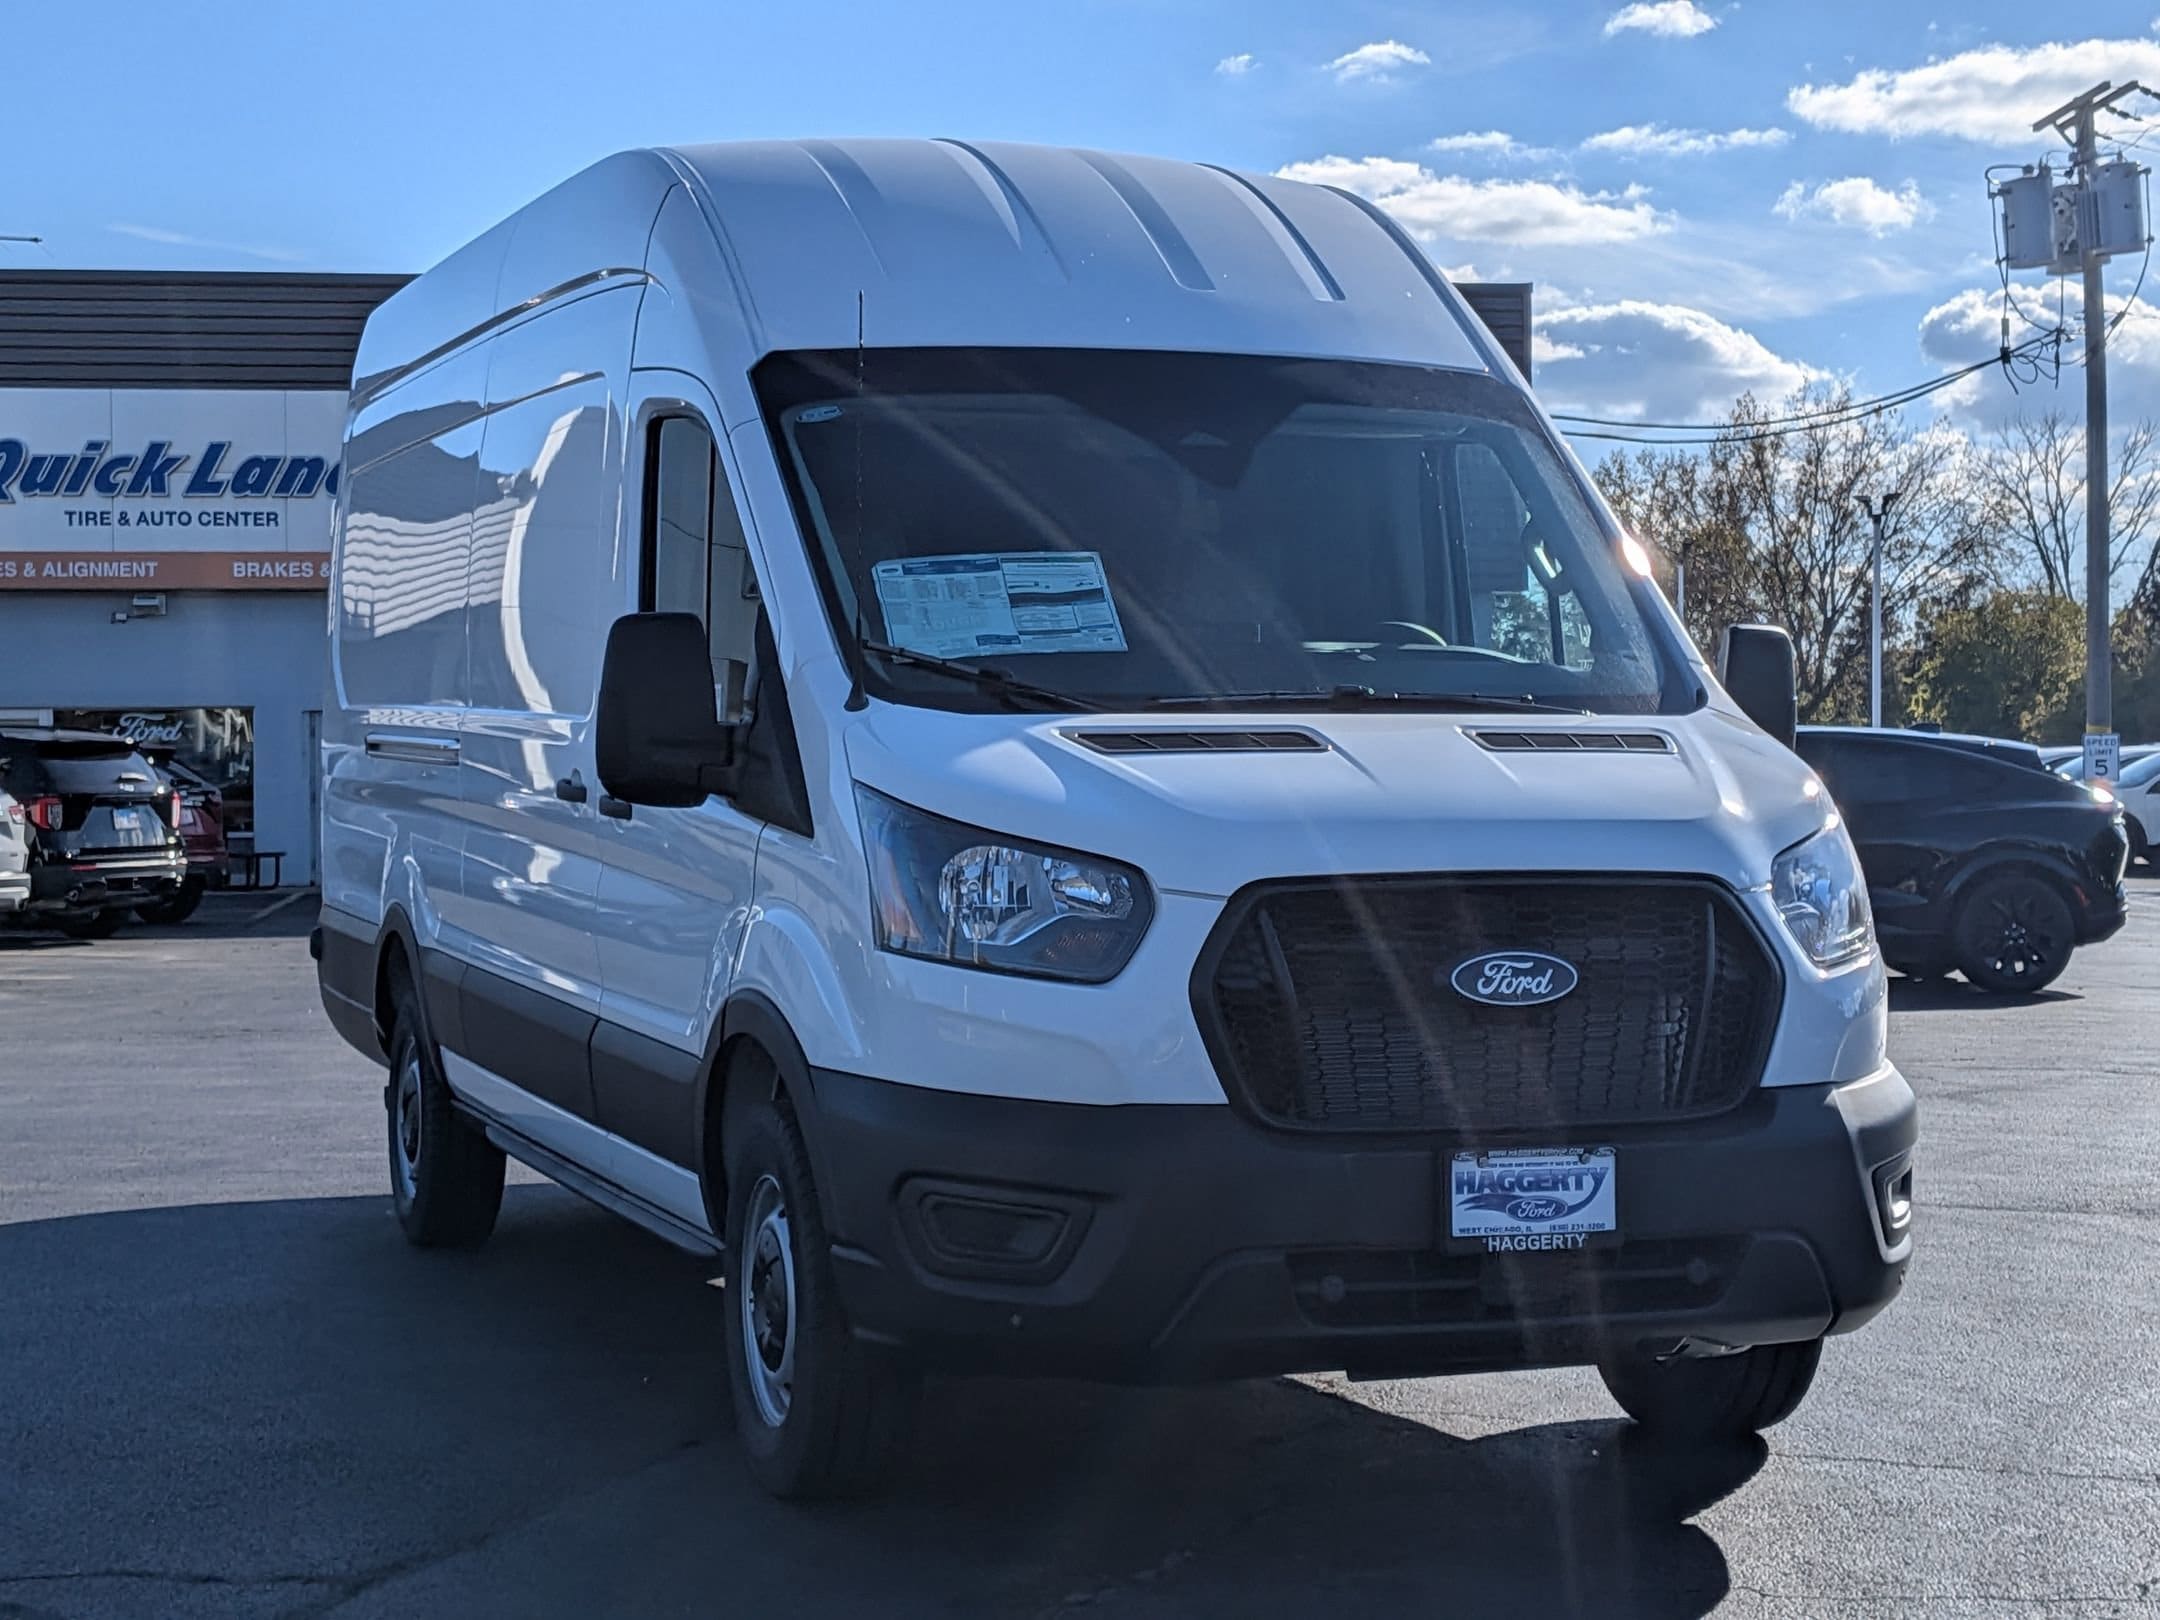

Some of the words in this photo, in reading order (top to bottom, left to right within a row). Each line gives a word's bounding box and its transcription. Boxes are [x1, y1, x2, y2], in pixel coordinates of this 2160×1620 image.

[64, 511, 112, 527] TIRE
[118, 511, 131, 527] &
[137, 511, 193, 527] AUTO
[198, 511, 279, 527] CENTER
[23, 561, 36, 578] &
[42, 561, 158, 578] ALIGNMENT
[233, 561, 314, 578] BRAKES
[112, 712, 184, 742] Ford
[2086, 738, 2117, 746] SPEED
[2089, 748, 2113, 756] LIMIT
[2095, 758, 2108, 776] 5
[1477, 960, 1554, 995] Ford
[1455, 1167, 1609, 1196] HAGGERTY
[1517, 1200, 1556, 1218] Ford
[1487, 1233, 1586, 1252] HAGGERTY
